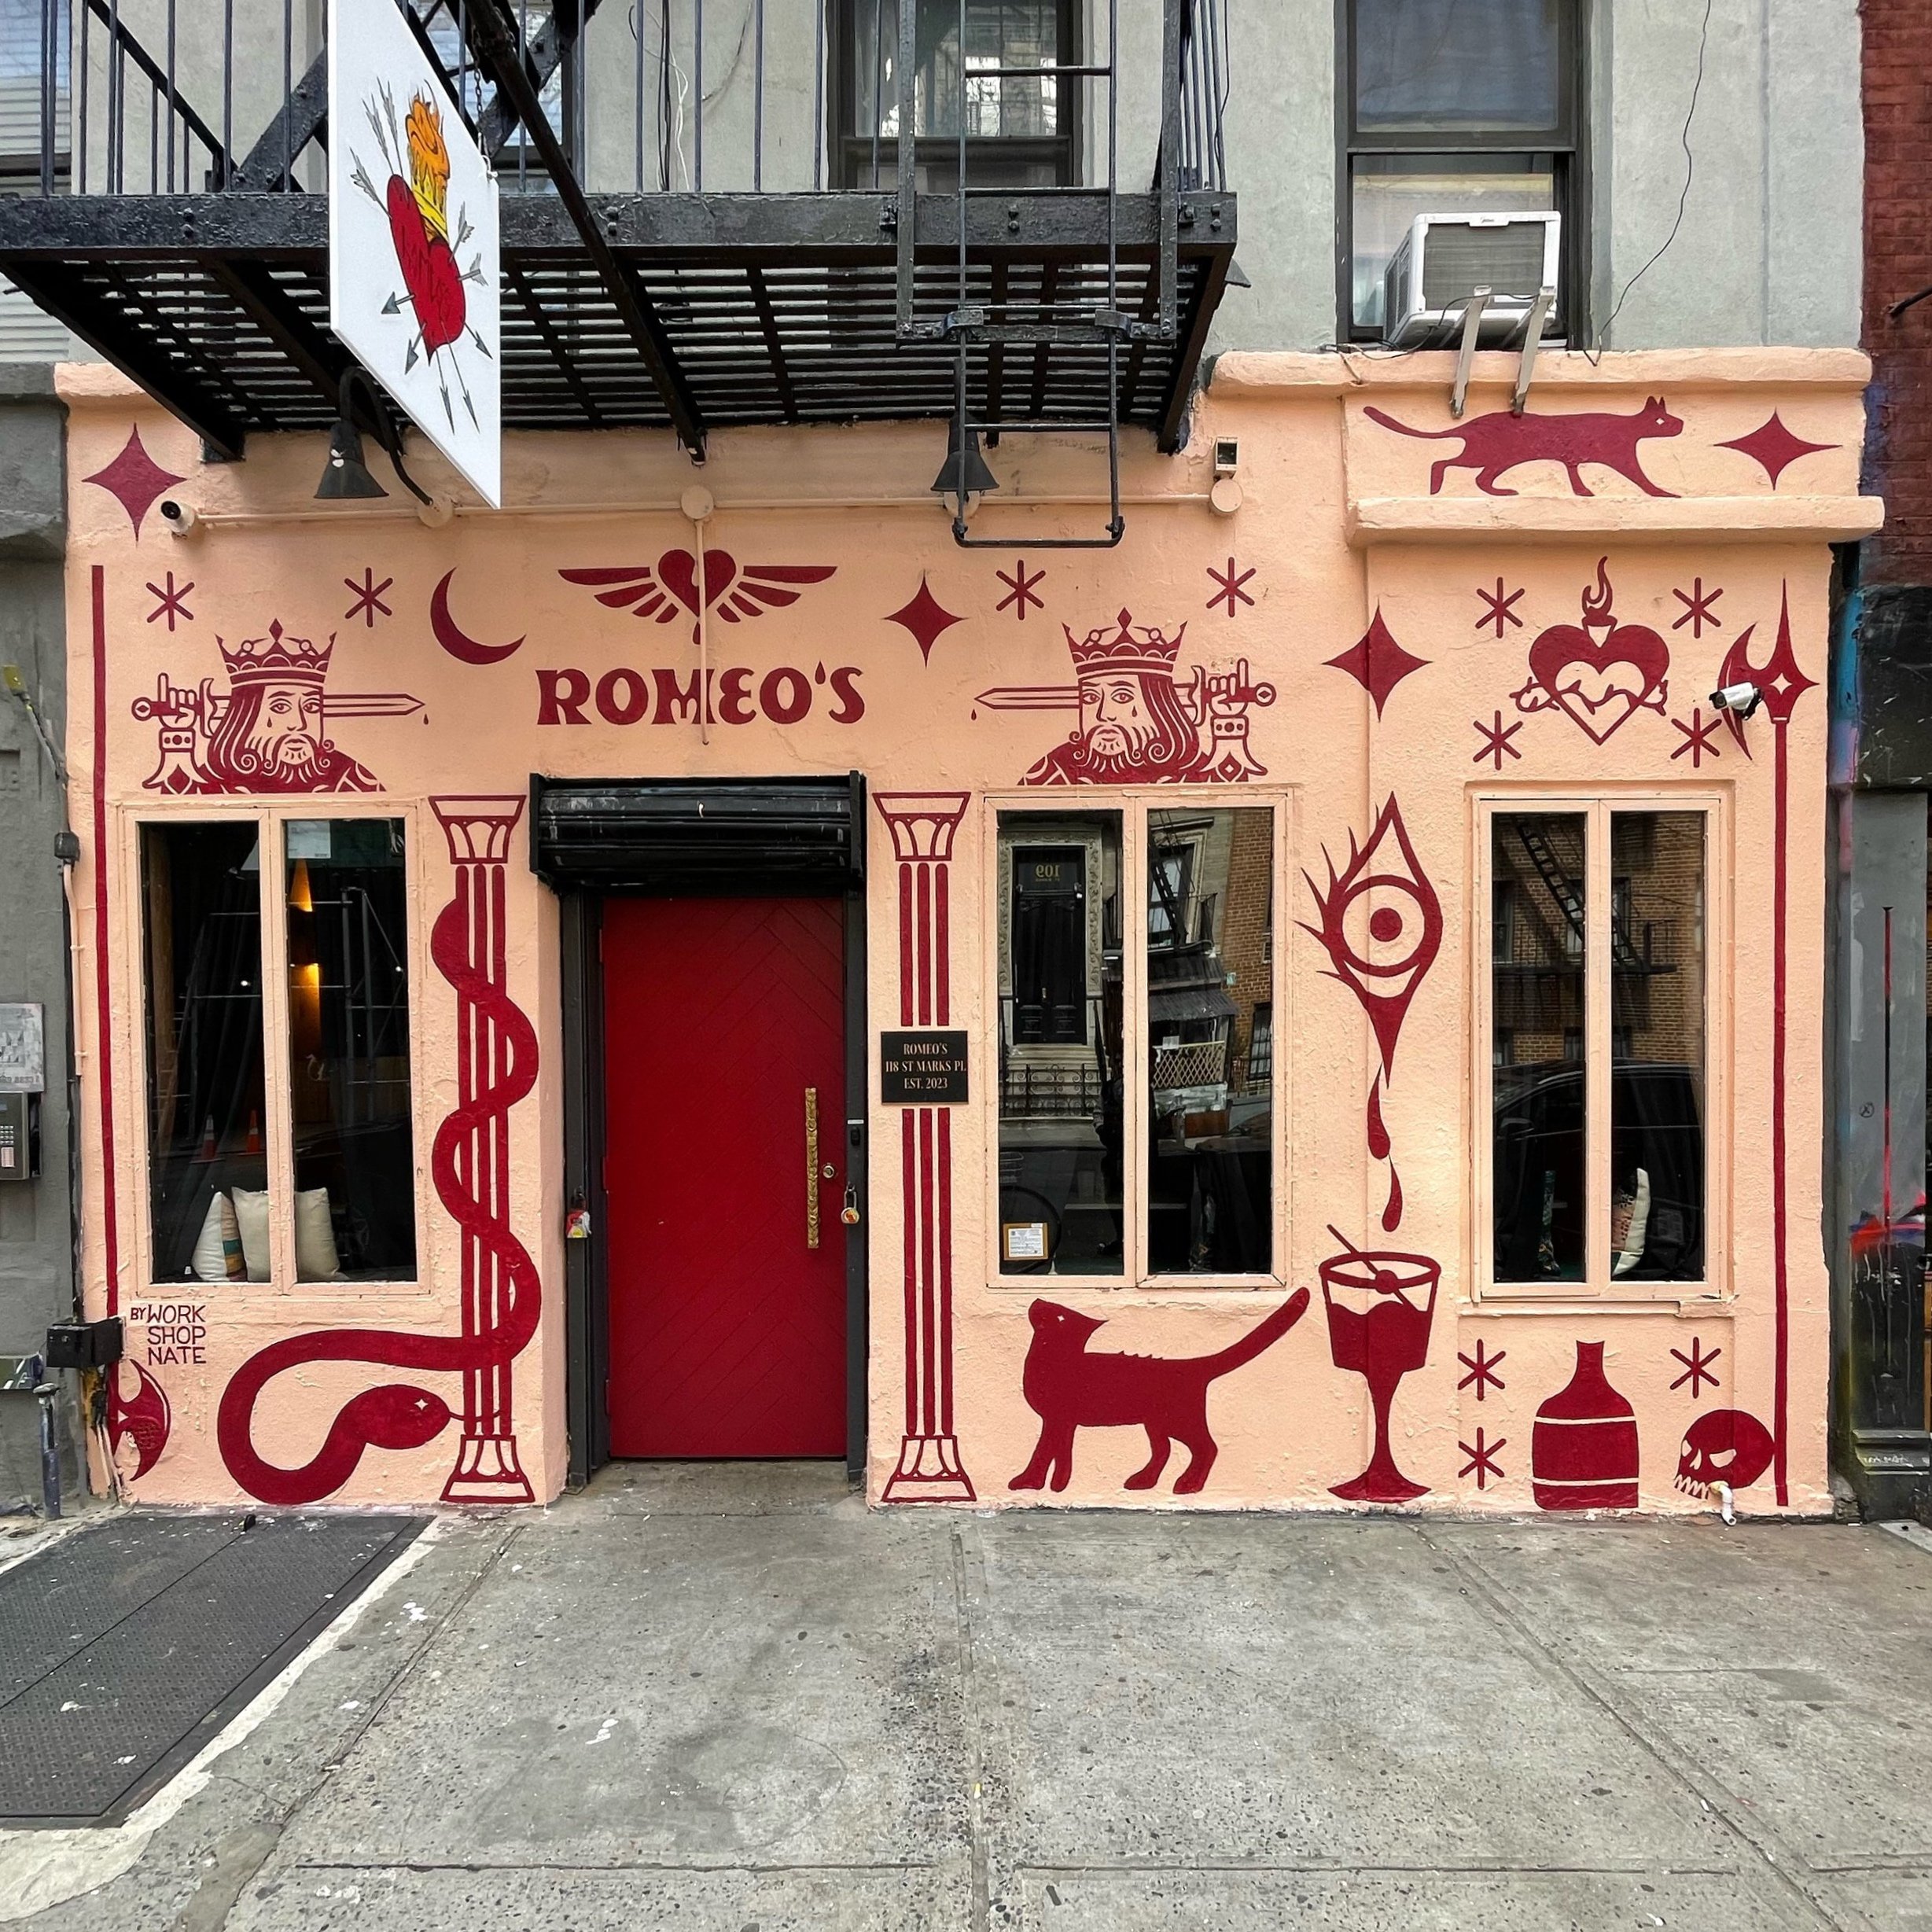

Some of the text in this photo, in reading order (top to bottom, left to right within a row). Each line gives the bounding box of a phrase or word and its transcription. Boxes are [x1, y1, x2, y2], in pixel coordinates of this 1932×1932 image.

[535, 661, 865, 725] ROMEO'S
[903, 1043, 948, 1055] ROMEO'S
[885, 1061, 899, 1072] 118
[902, 1061, 914, 1072] ST
[916, 1060, 951, 1072] MARKS
[904, 1077, 948, 1089] EST. 2023
[130, 1305, 206, 1323] BY WORK
[147, 1326, 206, 1345] SHOP
[148, 1346, 206, 1366] NATE
